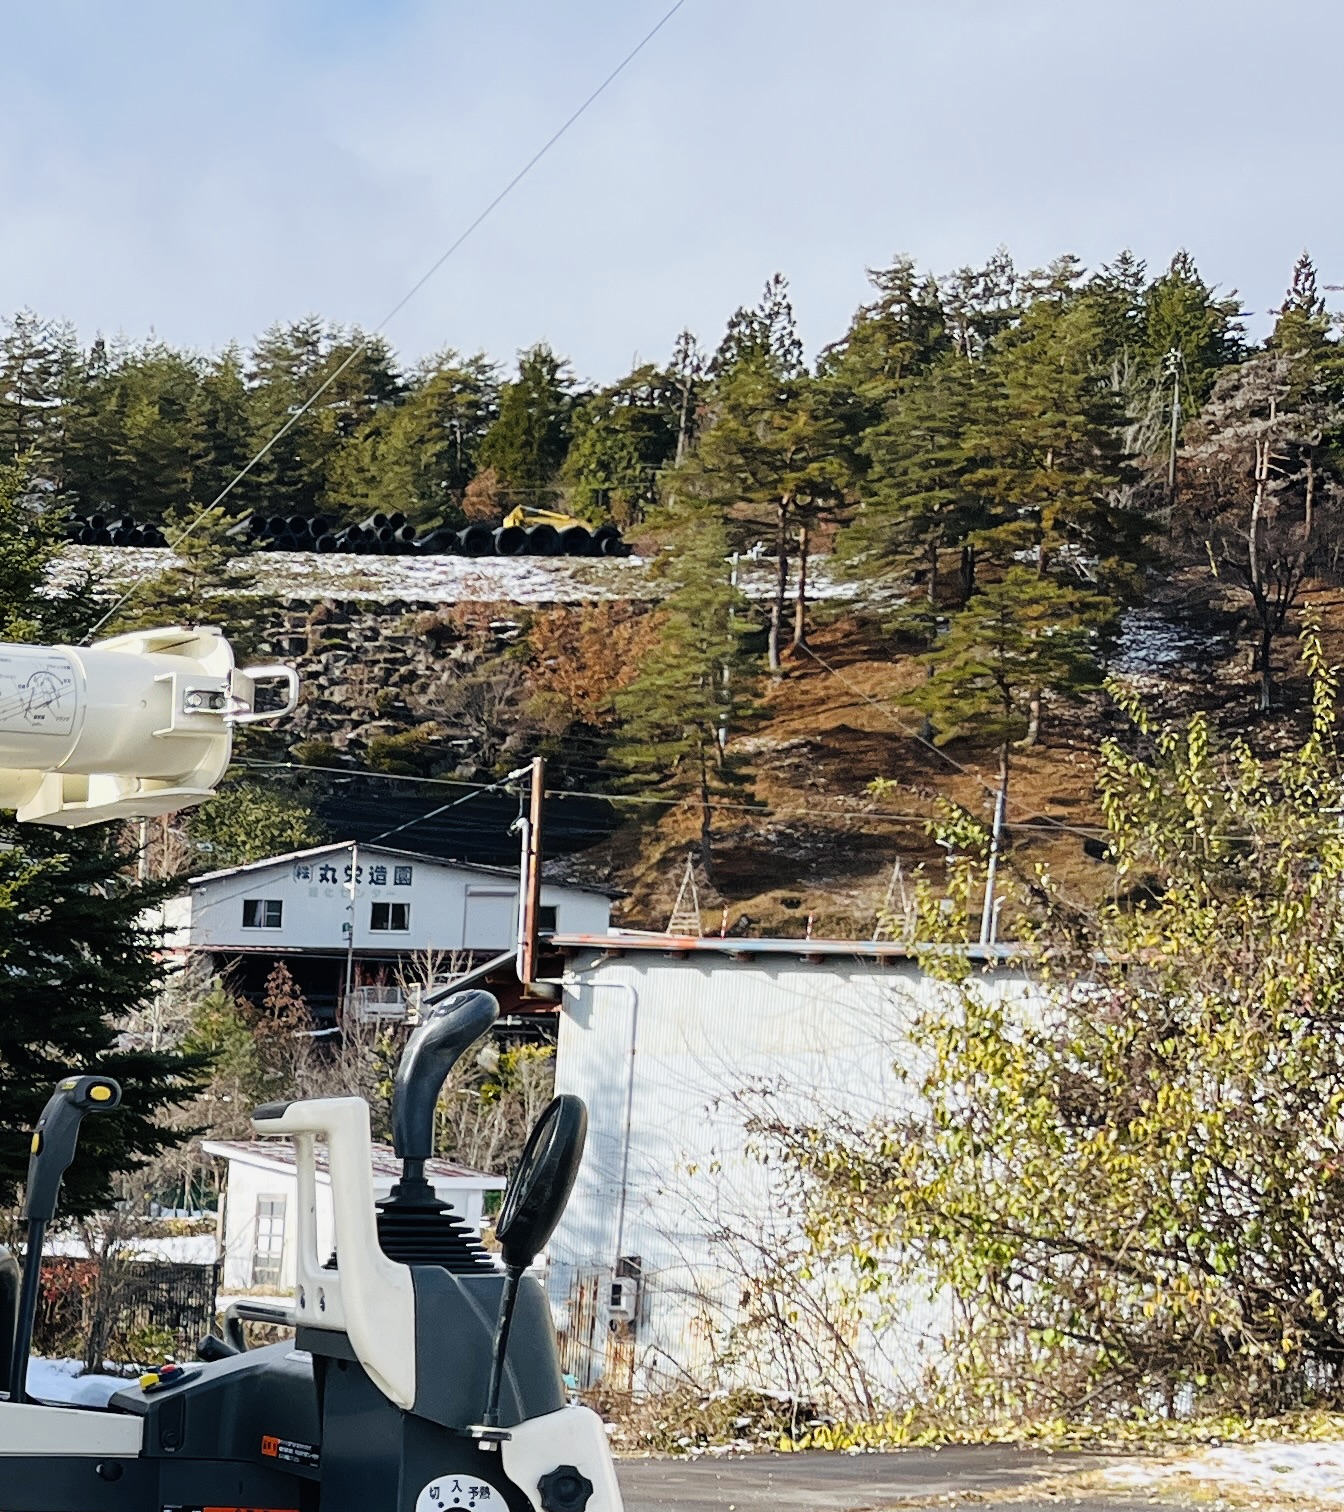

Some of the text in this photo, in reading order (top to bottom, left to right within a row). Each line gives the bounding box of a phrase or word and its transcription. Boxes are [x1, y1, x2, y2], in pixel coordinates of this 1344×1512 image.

[429, 1486, 441, 1500] 切
[451, 1479, 463, 1493] 入
[468, 1485, 491, 1500] 予熱
